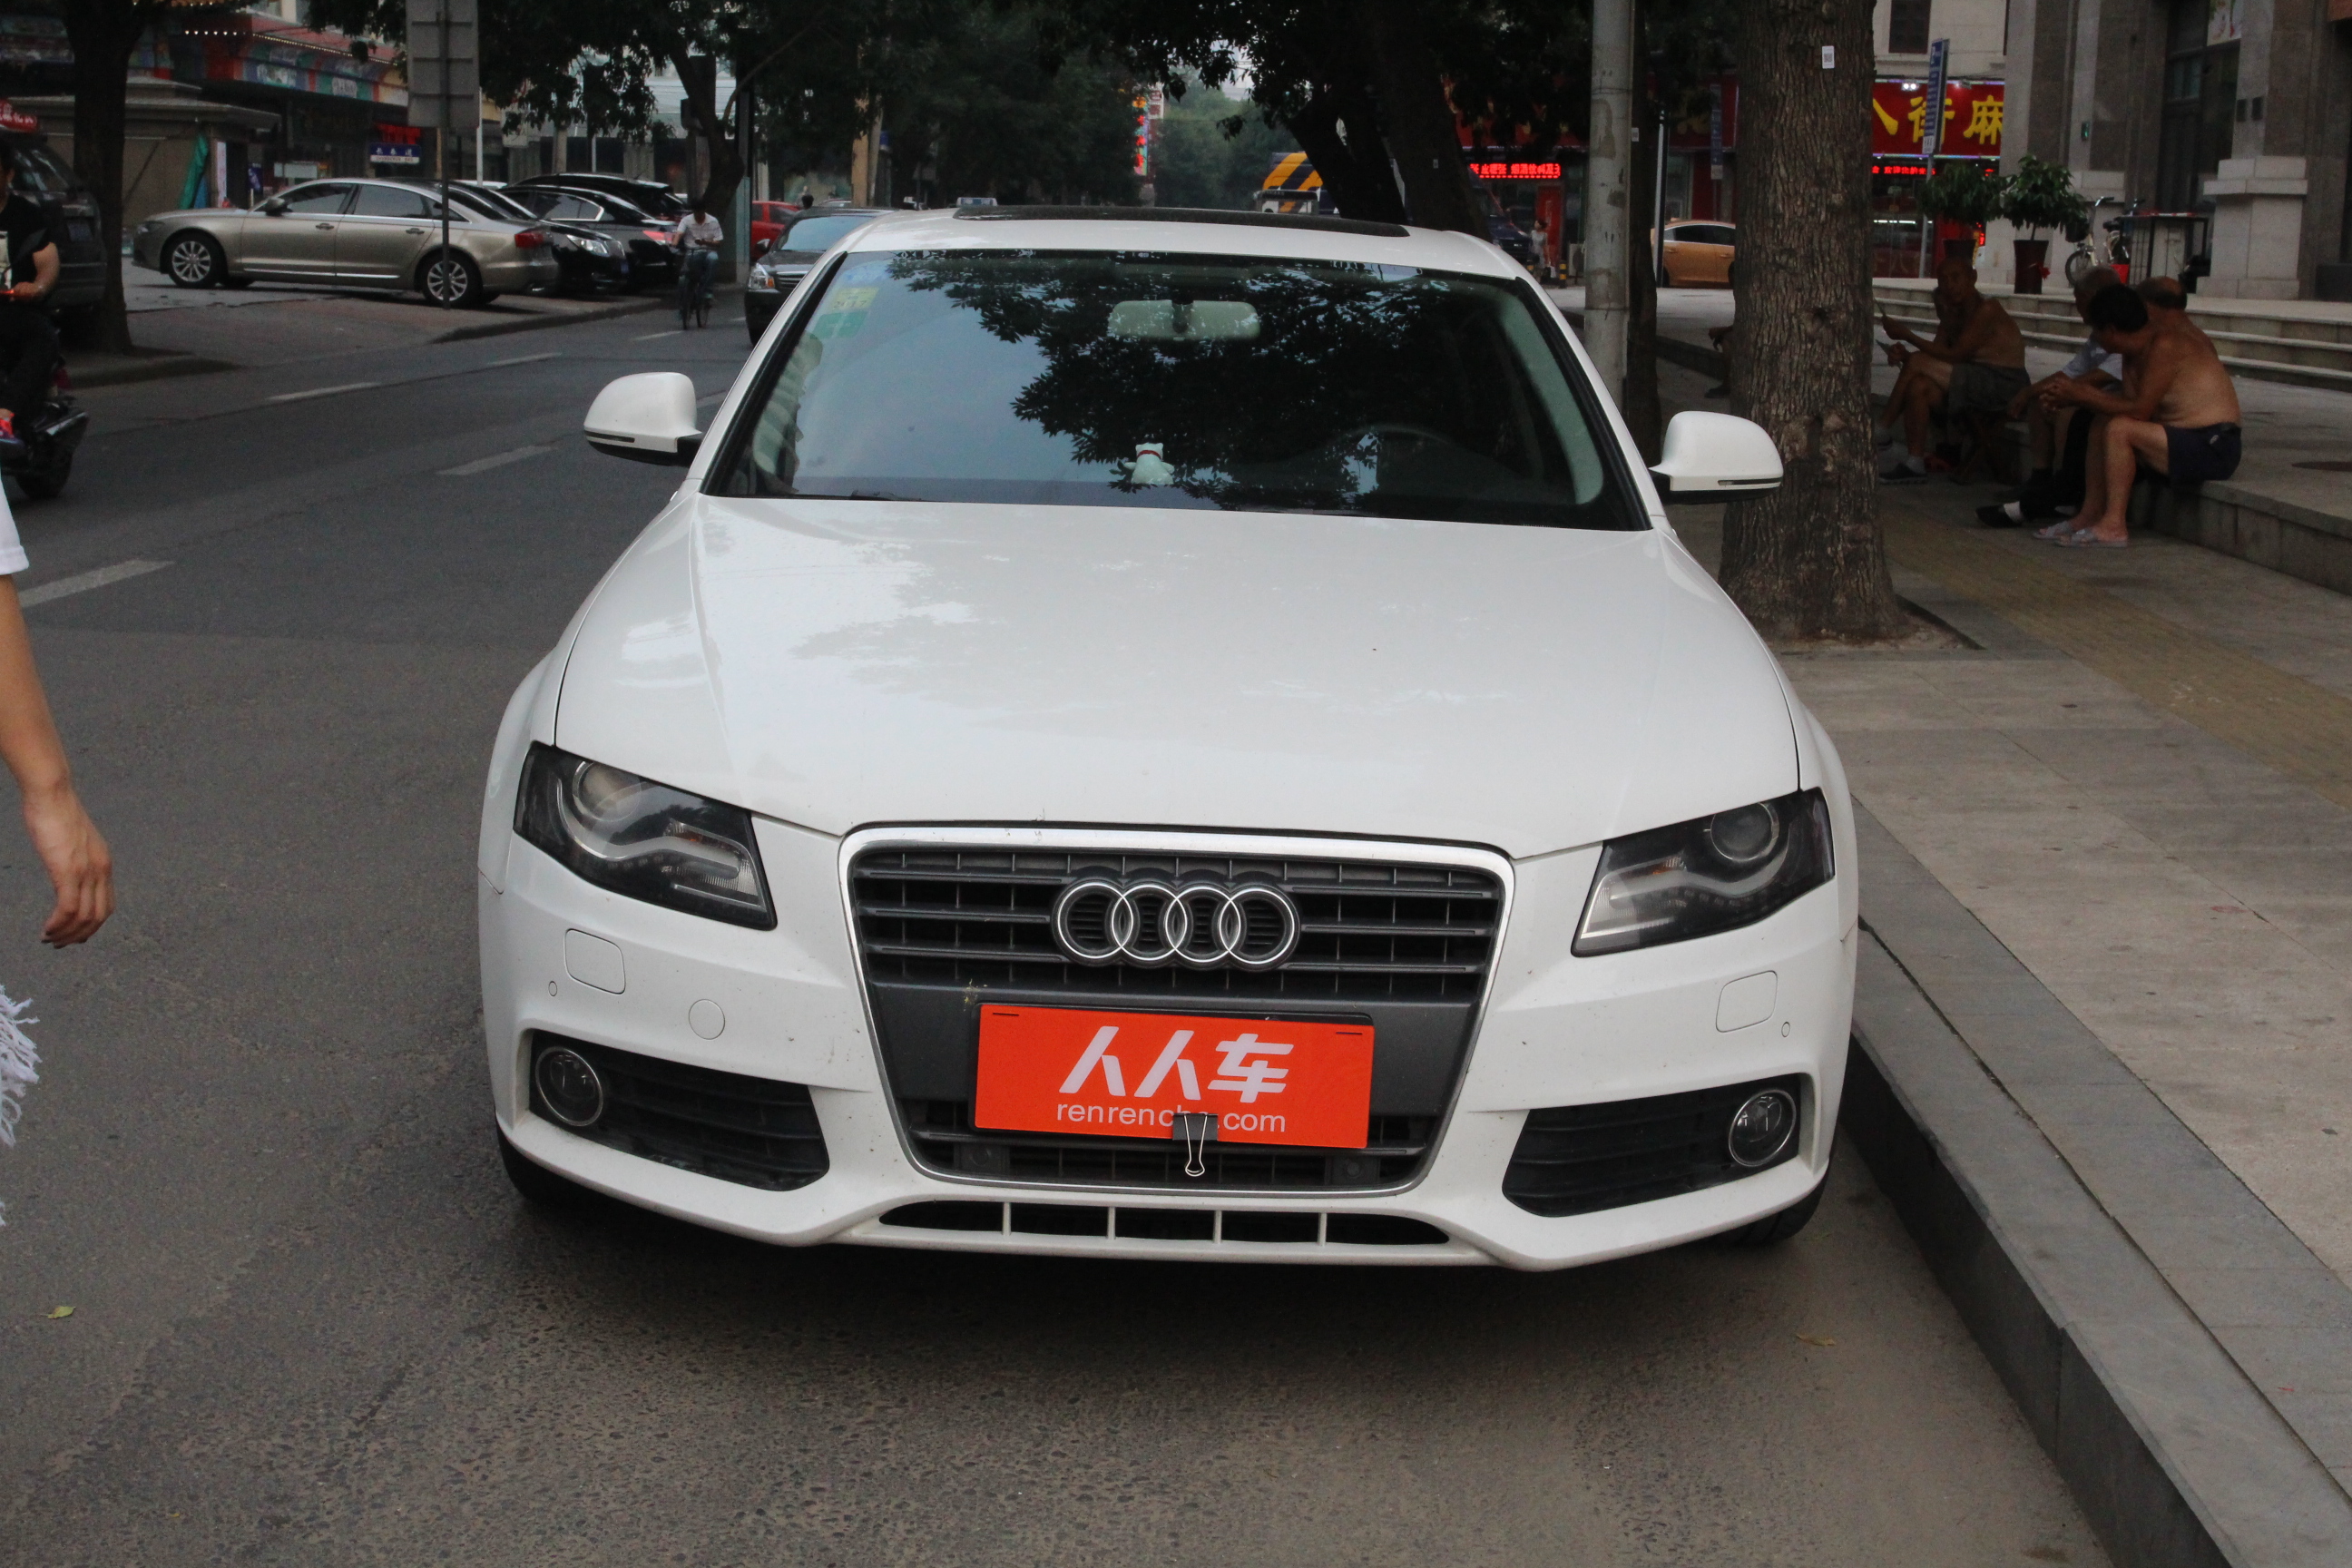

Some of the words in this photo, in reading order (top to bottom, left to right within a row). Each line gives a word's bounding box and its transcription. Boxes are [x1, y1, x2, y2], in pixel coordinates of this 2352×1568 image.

[1059, 1025, 1294, 1103] 人人车
[1056, 1103, 1285, 1132] renrenc.com
